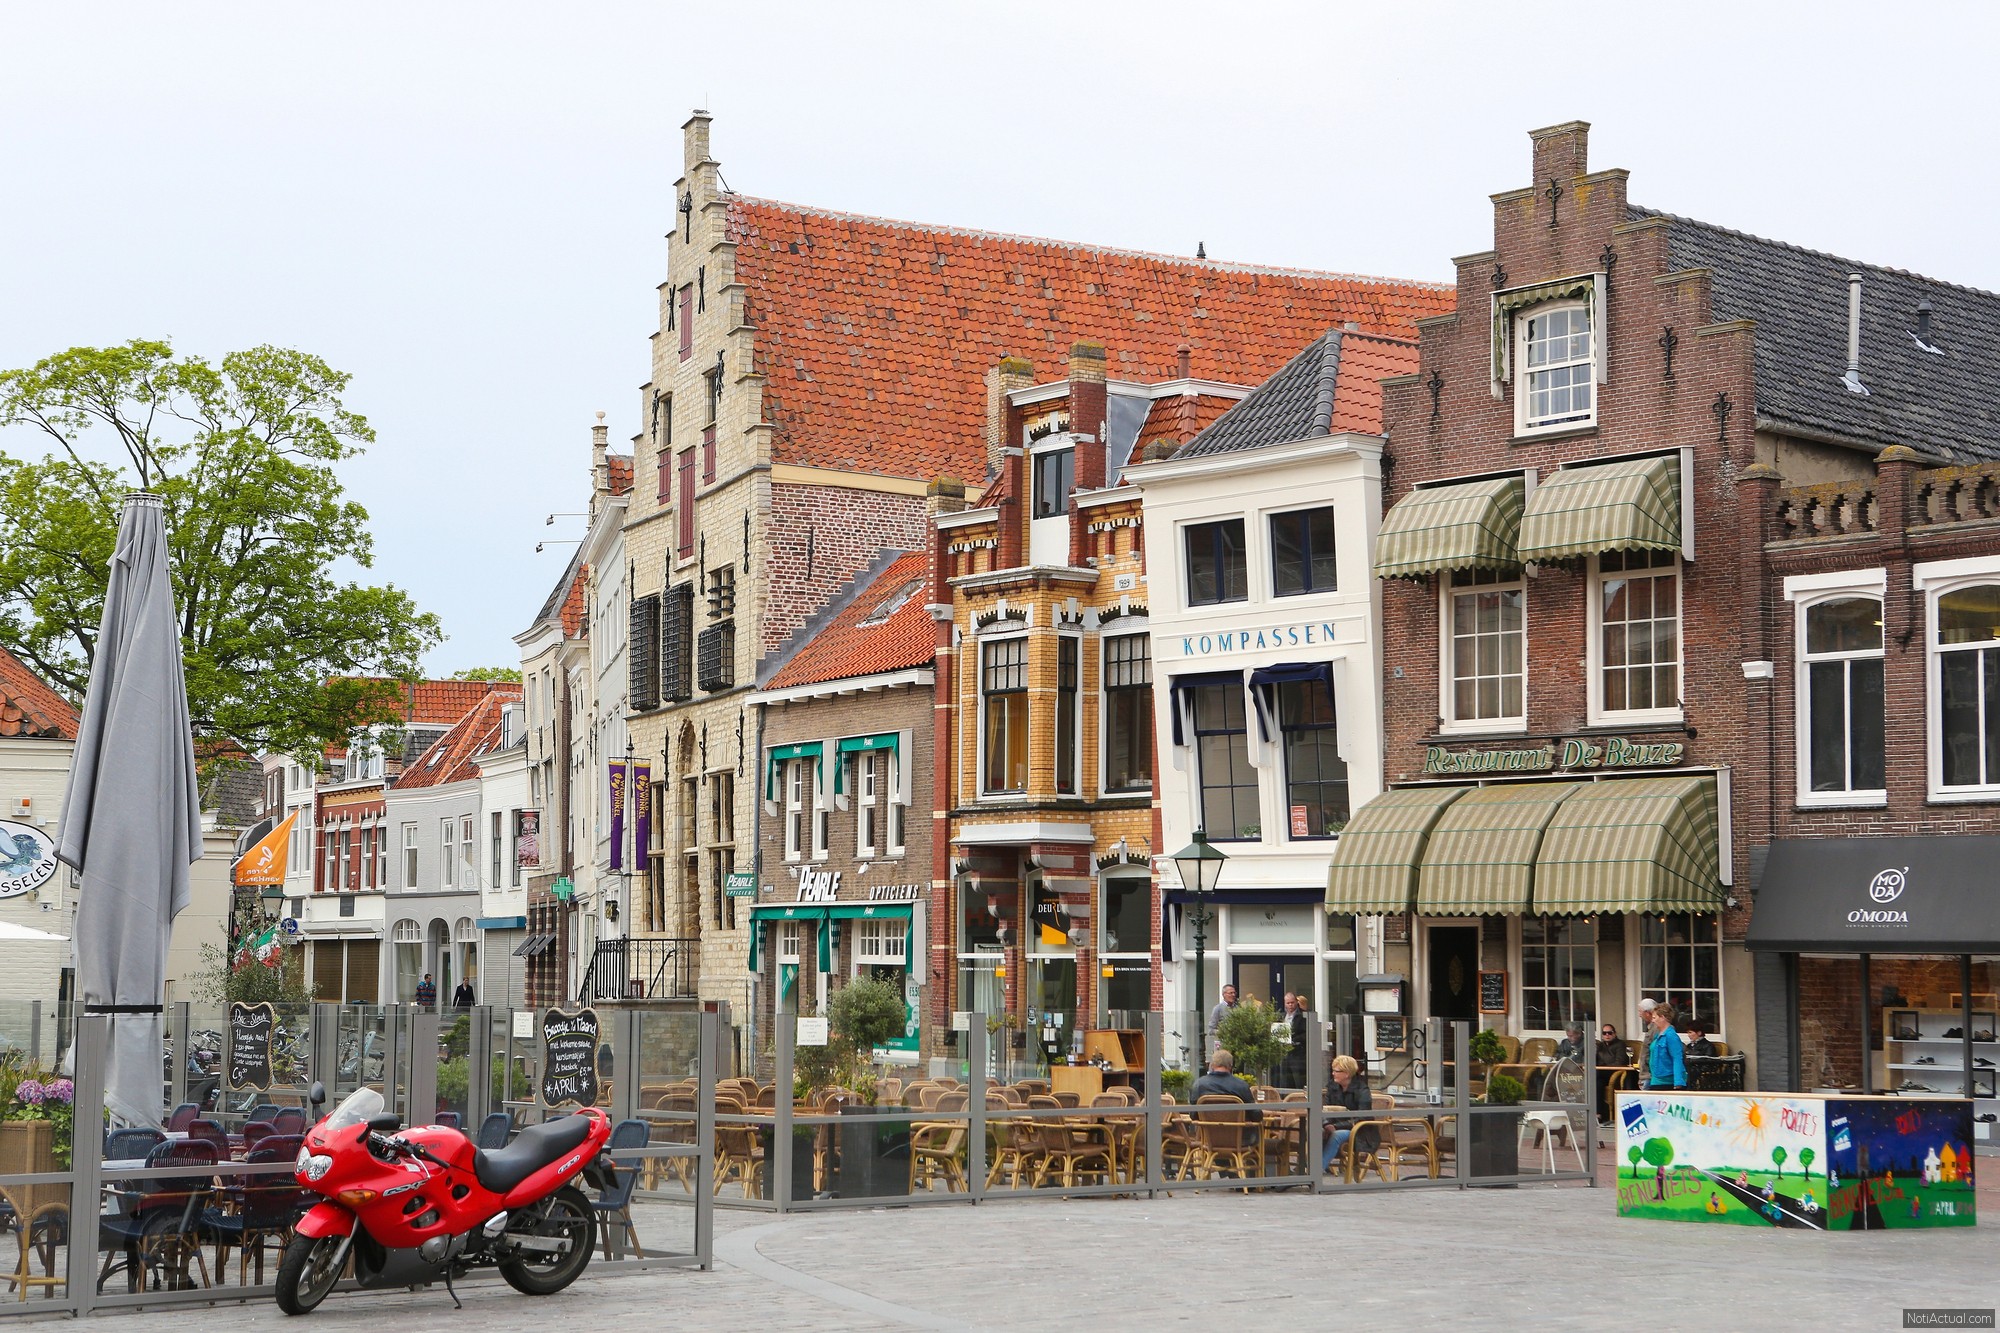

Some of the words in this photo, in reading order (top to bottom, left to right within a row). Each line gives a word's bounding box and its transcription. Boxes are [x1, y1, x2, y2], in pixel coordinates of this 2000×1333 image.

[1183, 623, 1335, 655] KOMPASSEN
[1423, 746, 1555, 773] Restaurant
[1561, 740, 1600, 768] De
[1602, 738, 1683, 766] Beuze
[726, 875, 754, 887] PEARLE
[797, 865, 840, 902] PEARLE
[869, 885, 919, 900] OPTICIENS
[1847, 908, 1908, 922] O'MODA
[544, 1021, 570, 1040] Broodje
[577, 1017, 597, 1036] Maand
[553, 1076, 578, 1098] APRIL
[1667, 1104, 1694, 1122] APRIL
[1935, 1201, 1956, 1216] APRIL
